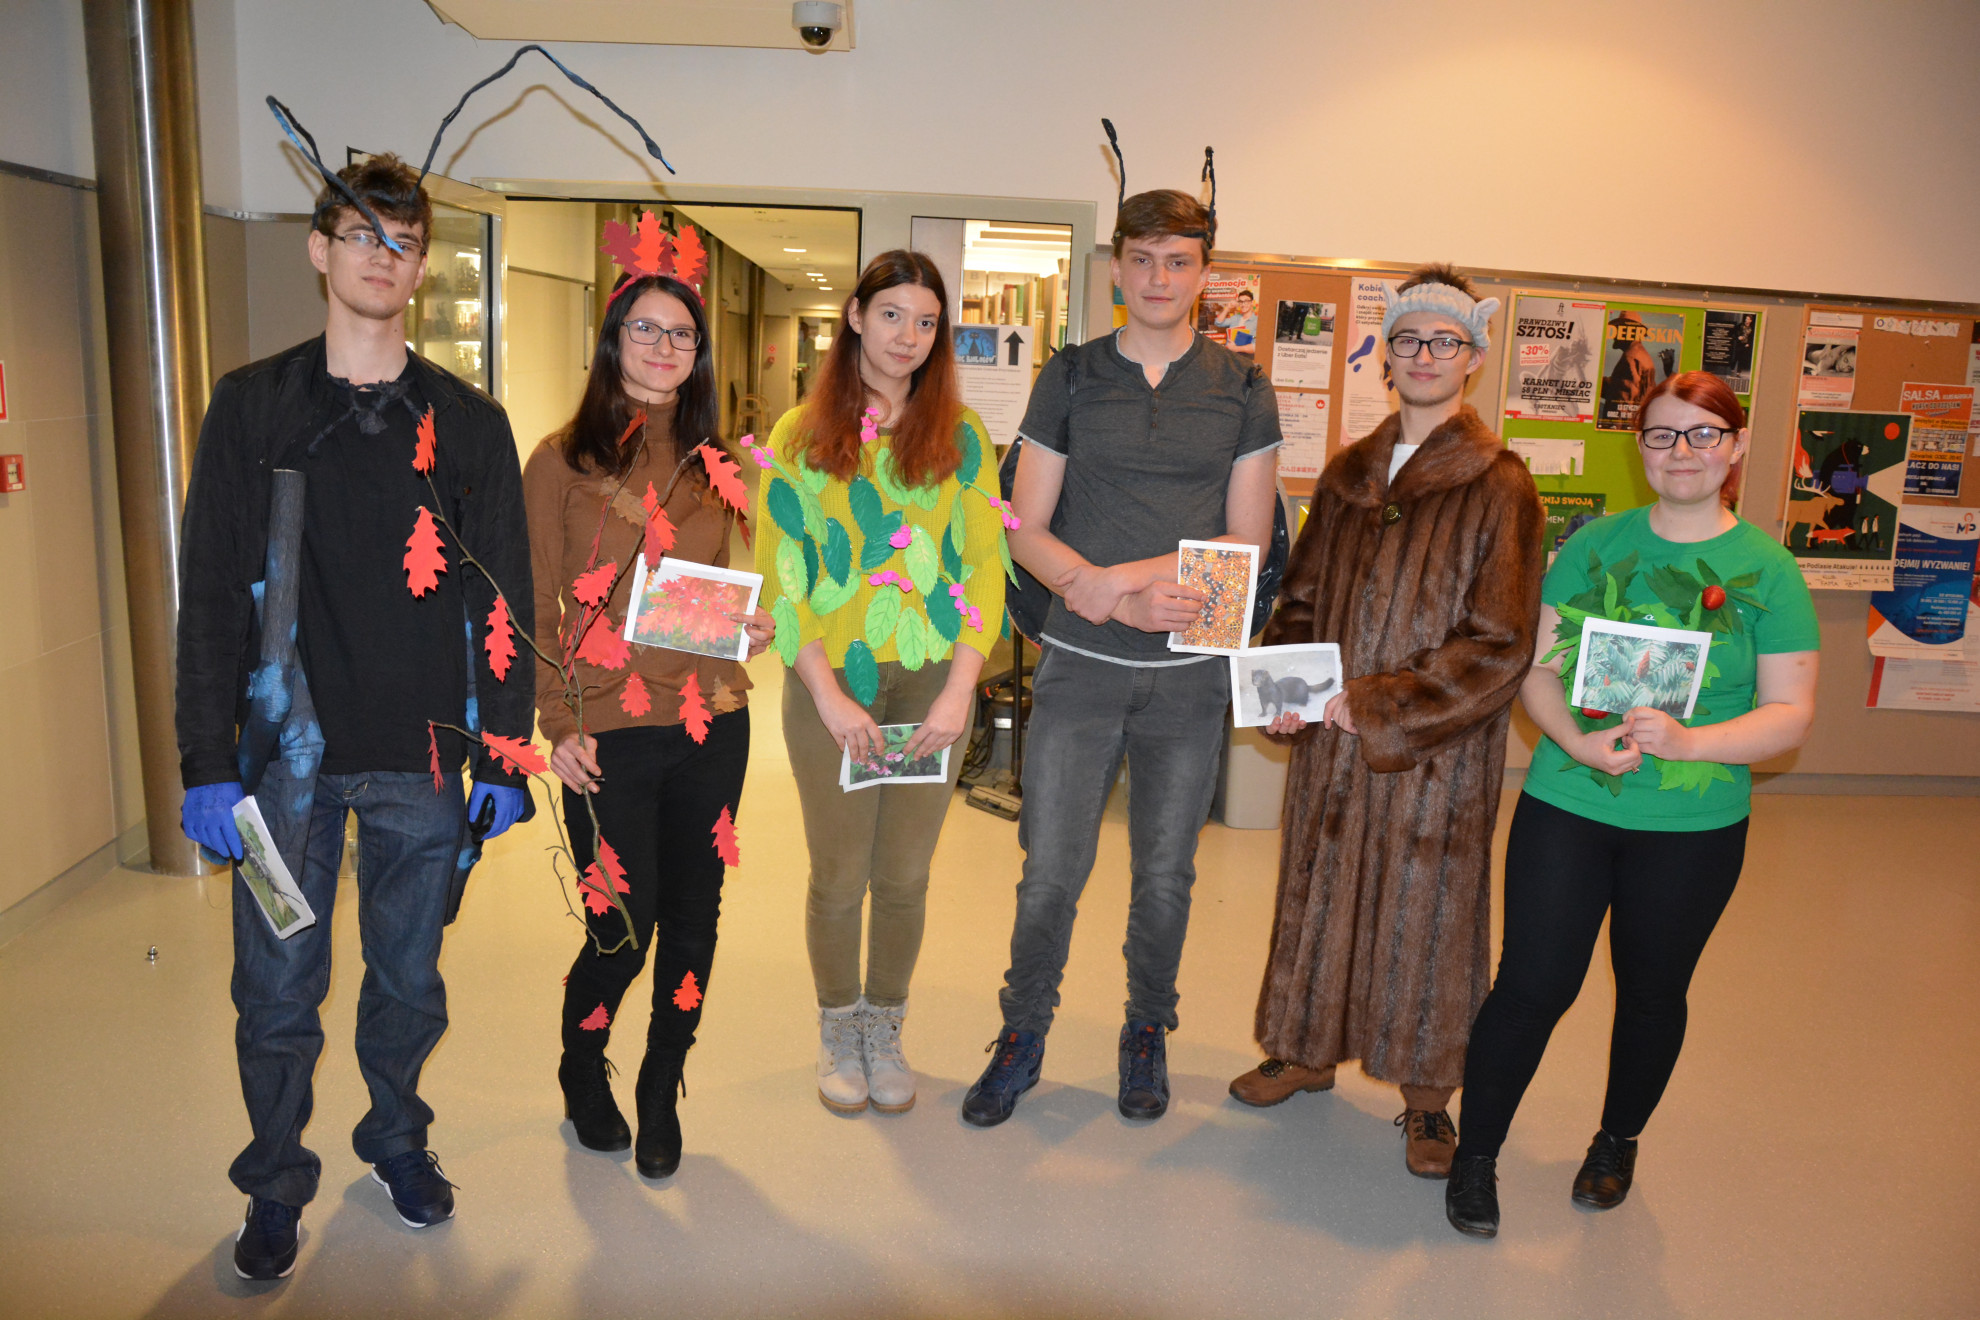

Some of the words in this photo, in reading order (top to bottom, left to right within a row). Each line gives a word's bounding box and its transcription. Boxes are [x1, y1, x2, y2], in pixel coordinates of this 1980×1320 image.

[1205, 279, 1247, 288] Promocja
[1519, 318, 1567, 327] PRAWDZIWY
[1516, 322, 1574, 340] SZTOS!
[1607, 324, 1684, 344] DEERSKIN
[1521, 345, 1549, 356] -30%
[1522, 377, 1560, 387] KARNET
[1561, 379, 1577, 388] JUŻ
[1578, 381, 1593, 389] OD
[1555, 389, 1591, 397] MIESIĄC
[1903, 390, 1940, 400] SALSA
[1562, 496, 1594, 509] SWOJĄ
[1922, 560, 1970, 571] WYZWANIE!
